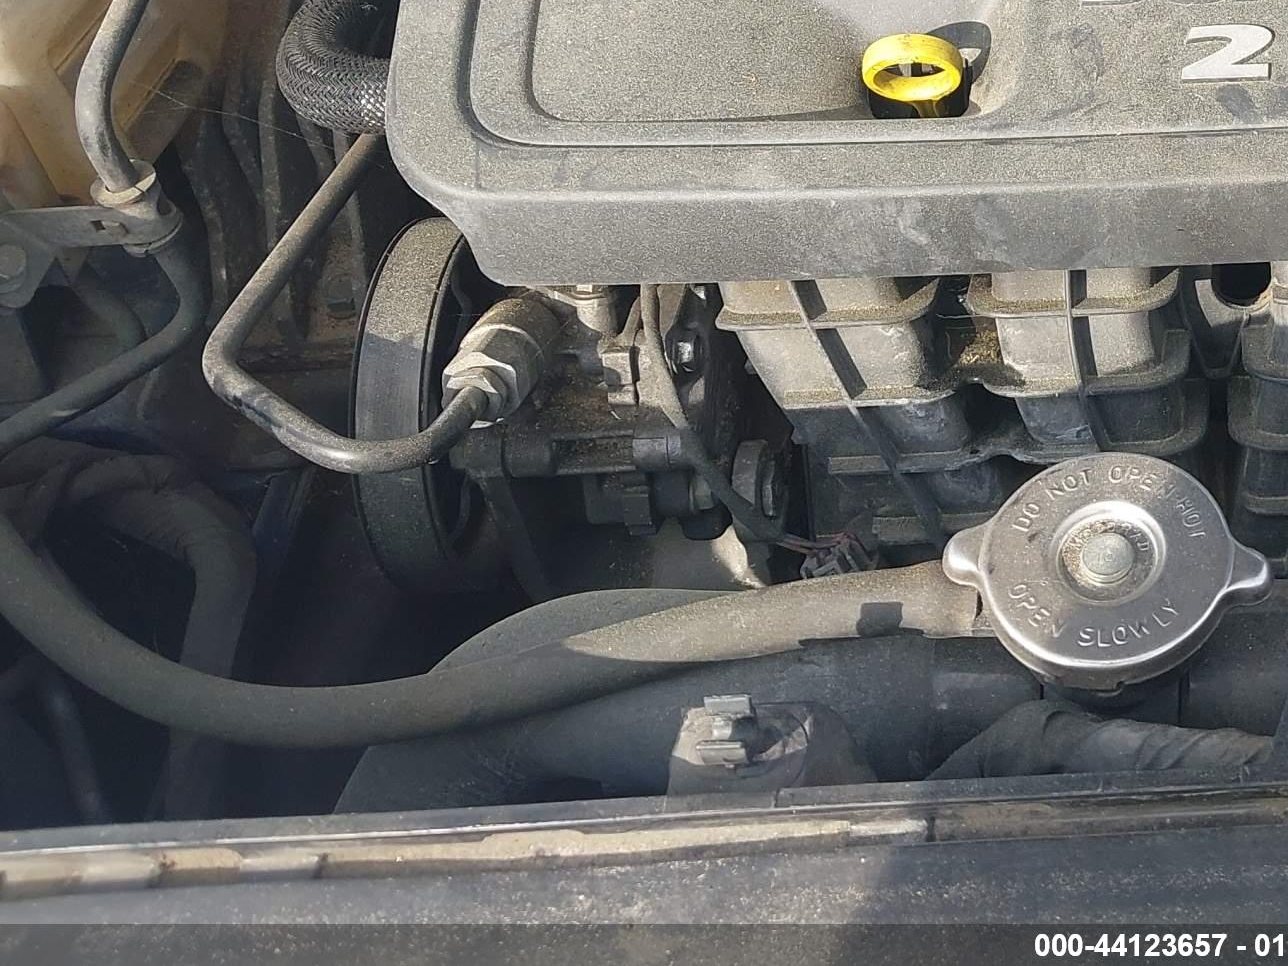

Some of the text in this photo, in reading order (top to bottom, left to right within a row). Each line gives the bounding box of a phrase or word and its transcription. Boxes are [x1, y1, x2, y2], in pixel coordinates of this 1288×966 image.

[1011, 464, 1206, 539] DO NOT OPEN HOT
[1007, 584, 1180, 648] OPEN SLOWLY
